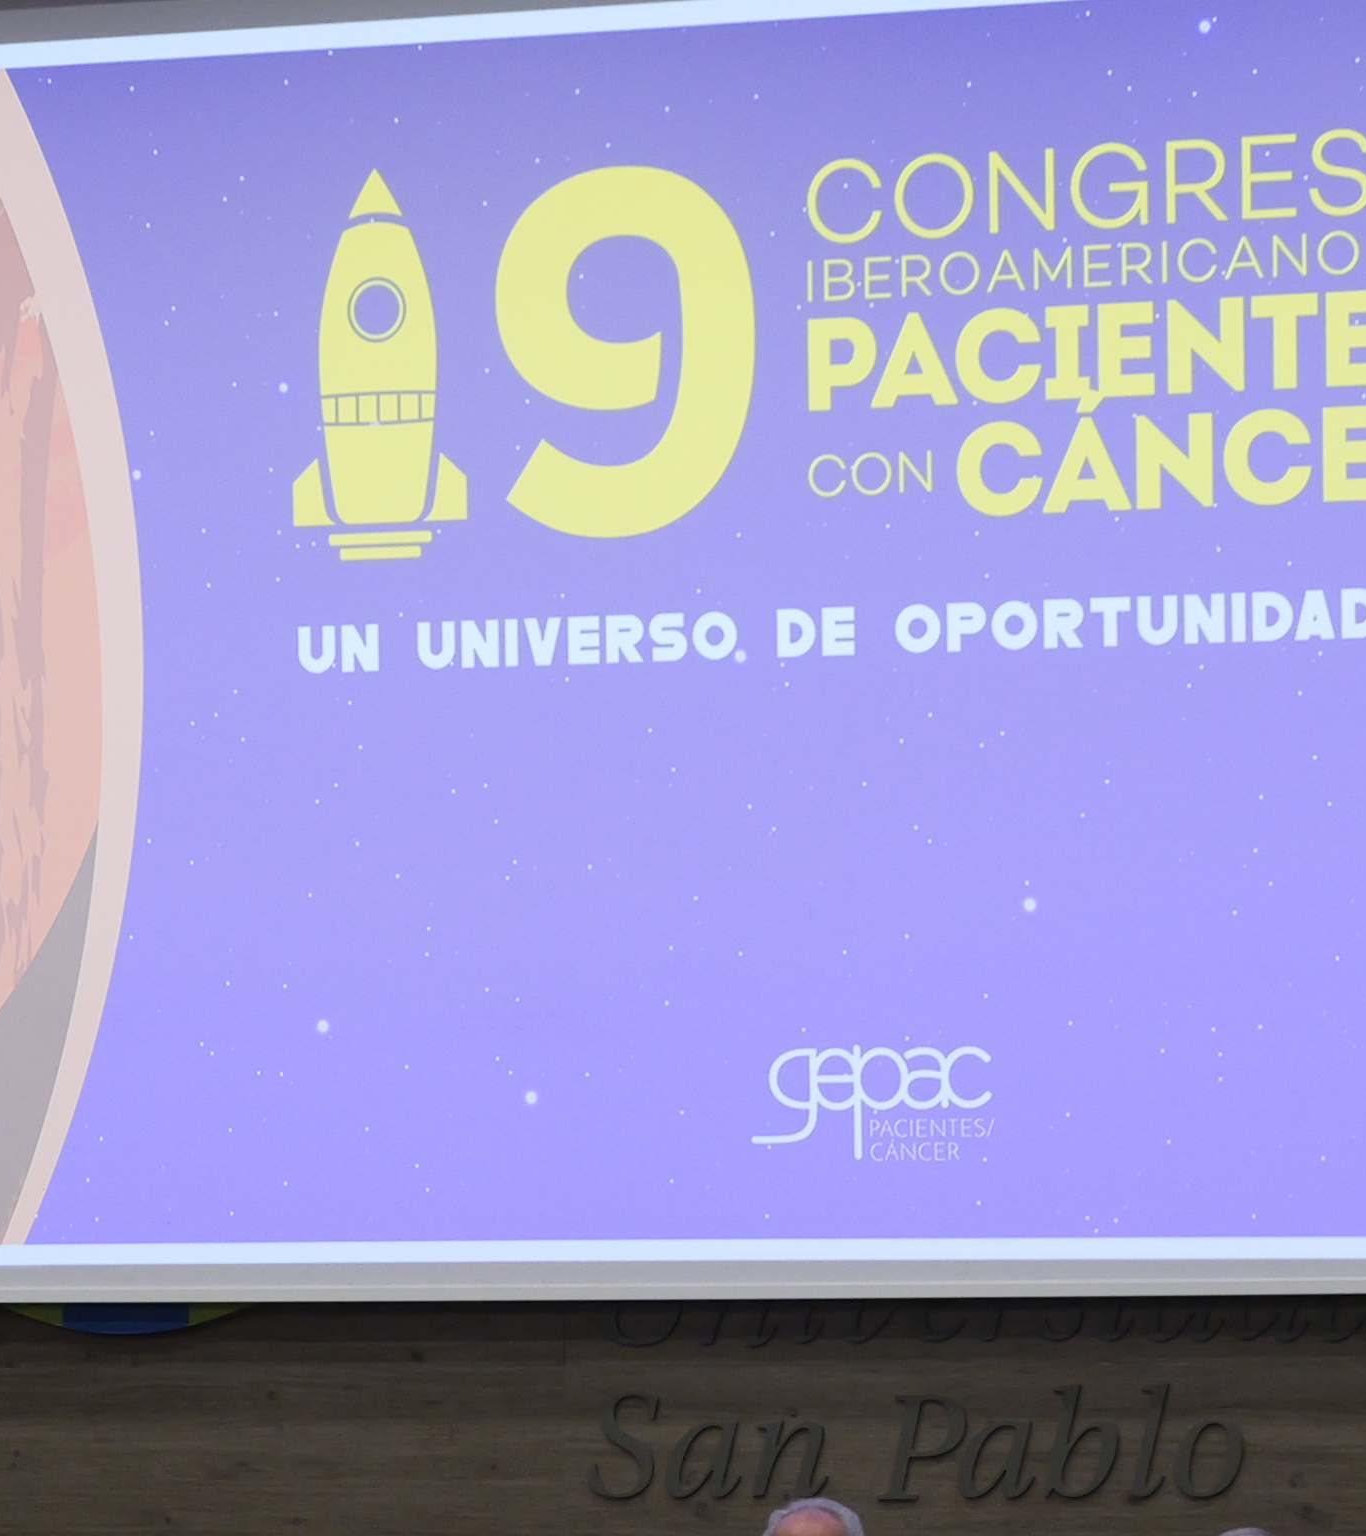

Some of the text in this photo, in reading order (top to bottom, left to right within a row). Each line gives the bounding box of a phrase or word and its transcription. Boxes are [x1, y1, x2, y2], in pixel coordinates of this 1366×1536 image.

[807, 230, 1360, 304] IBEROAMERICANO
[807, 449, 935, 498] CON
[297, 623, 380, 674] UN
[416, 611, 737, 669] UNIVERSO
[775, 605, 857, 658] DE
[751, 1044, 992, 1160] gepac
[870, 1139, 961, 1162] CÁNCER
[588, 1382, 1246, 1503] San Pablo
